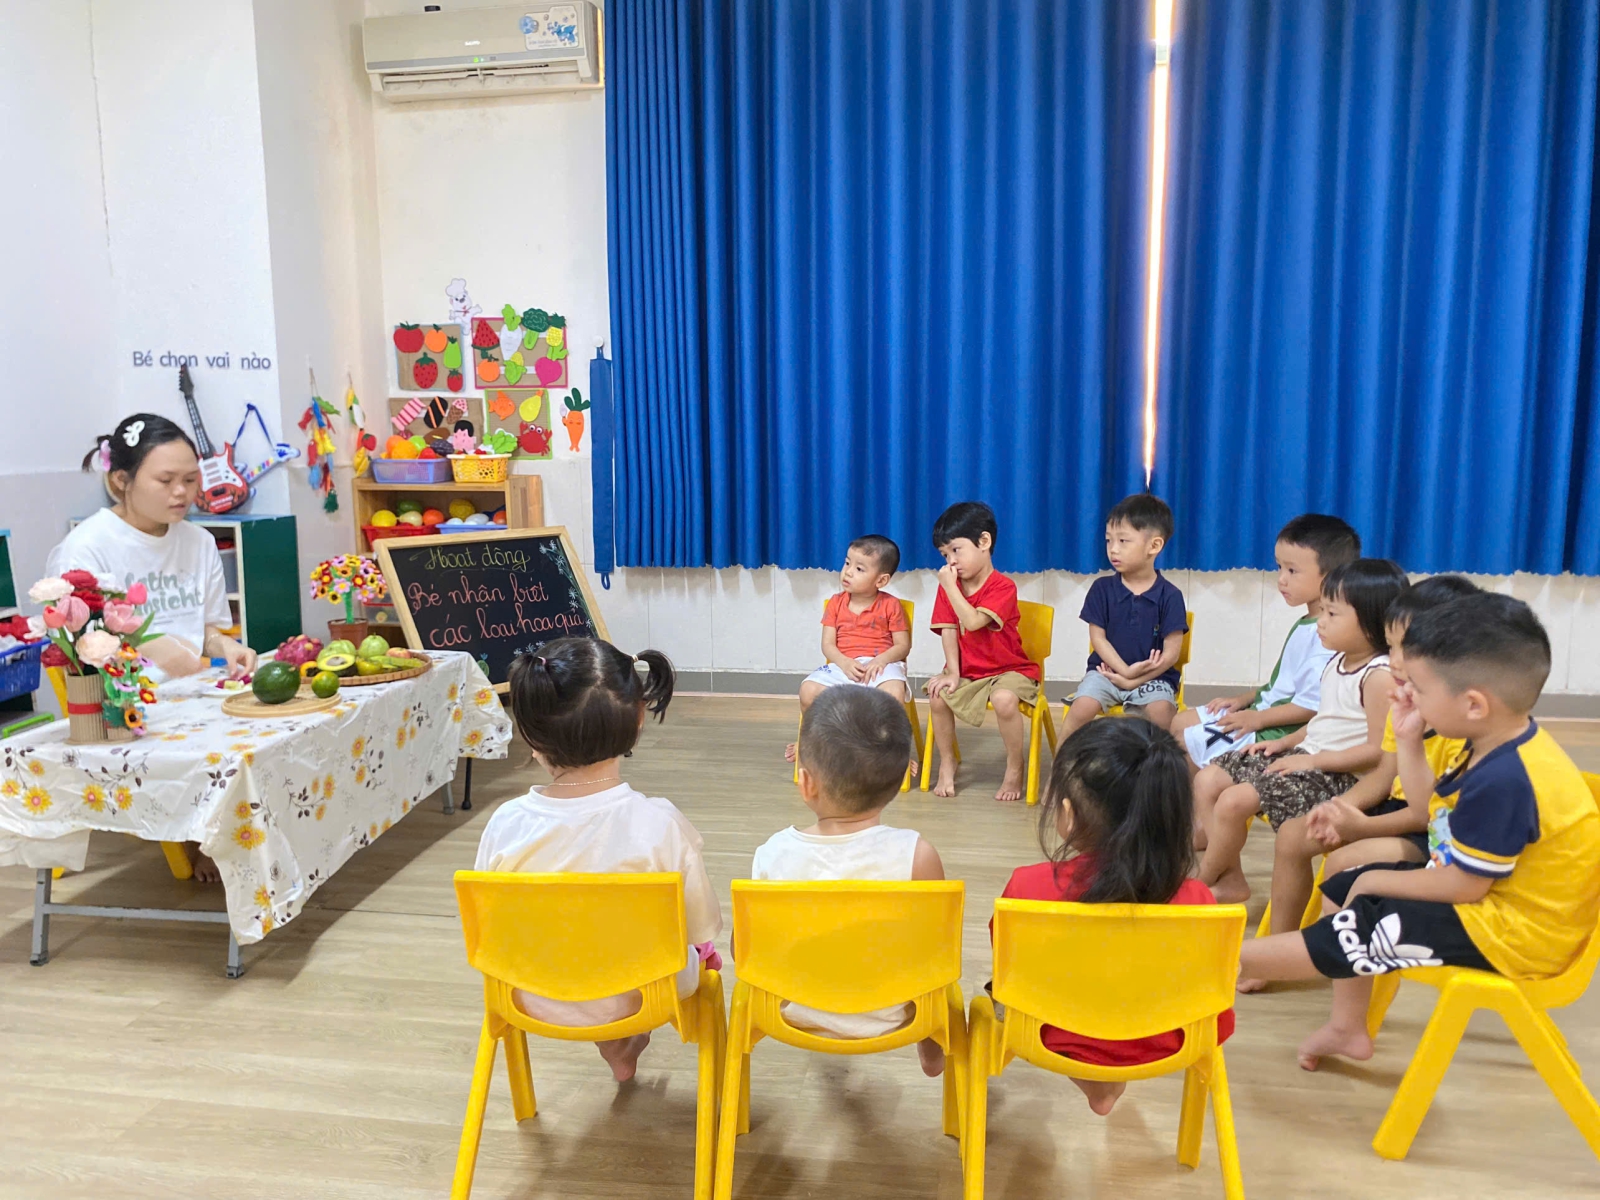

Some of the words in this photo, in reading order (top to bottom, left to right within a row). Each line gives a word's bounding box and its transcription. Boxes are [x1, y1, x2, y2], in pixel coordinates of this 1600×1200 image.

[133, 350, 153, 367] Bé
[206, 352, 231, 369] vai
[241, 352, 272, 370] nào
[407, 582, 443, 613] Bé
[448, 575, 506, 607] nhận
[509, 572, 549, 602] biết
[429, 613, 472, 648] các
[514, 602, 554, 634] hoa
